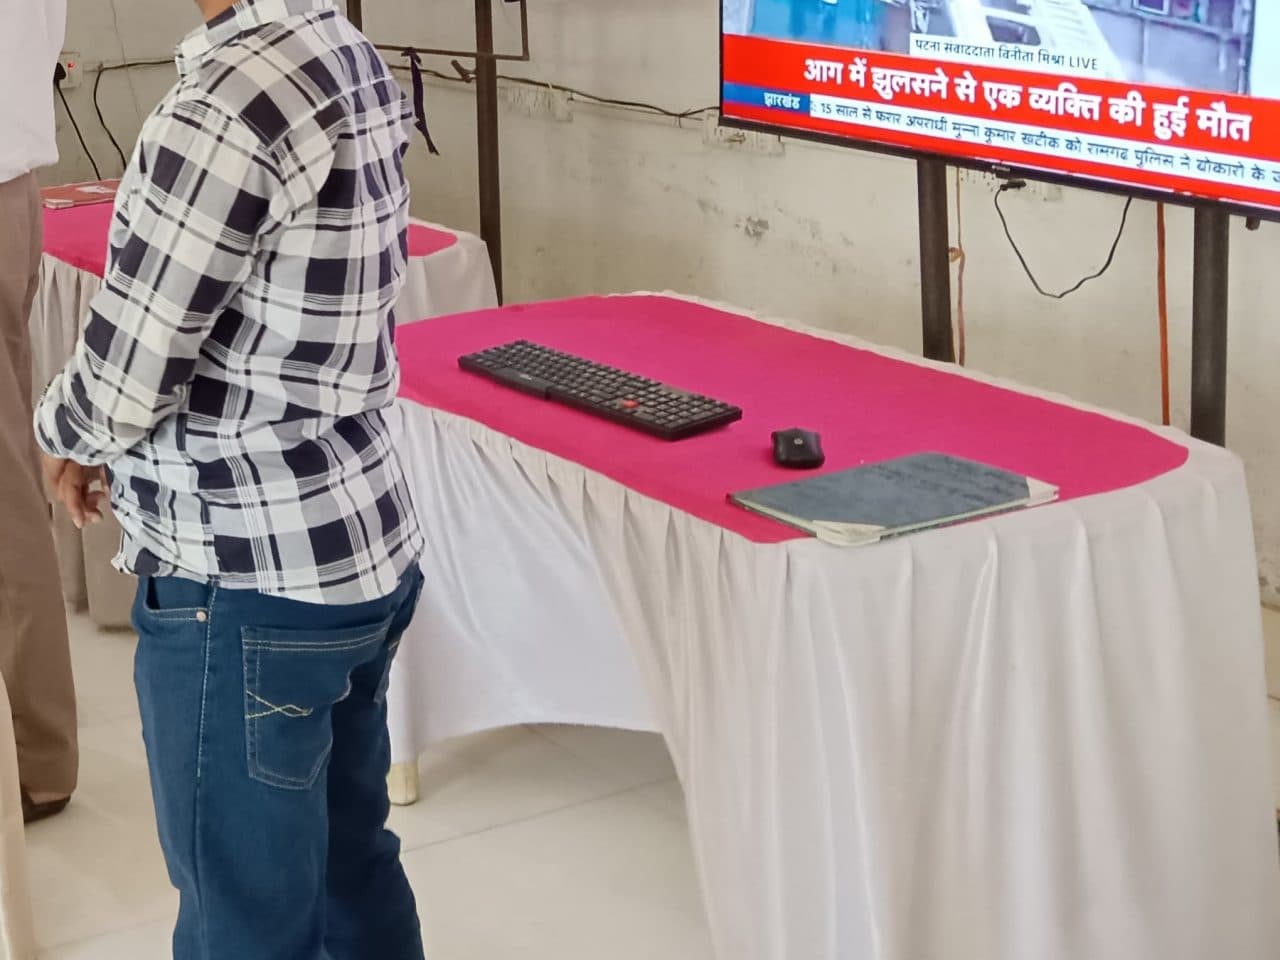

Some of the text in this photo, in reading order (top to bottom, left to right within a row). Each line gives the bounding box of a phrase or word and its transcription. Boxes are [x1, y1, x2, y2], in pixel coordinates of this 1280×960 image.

[915, 39, 940, 53] पटना
[999, 45, 1034, 63] विनीता
[1038, 49, 1066, 65] मिश्रा
[1069, 56, 1098, 70] LIVE
[763, 92, 800, 110] झारखंड
[804, 57, 1253, 142] आग में झुलसने से एक व्यक्ति की हुई मौत
[821, 103, 832, 114] 15
[835, 104, 858, 119] साल
[862, 105, 872, 121] से
[876, 110, 902, 125] फरार
[907, 115, 947, 133] अपराधी
[952, 122, 980, 138] मुन्ना
[984, 127, 1016, 144] कुमार
[1021, 131, 1060, 150] खटीक
[1065, 136, 1082, 153] को
[1134, 147, 1174, 168] पुलिस
[1180, 153, 1190, 170] ने
[1197, 156, 1244, 178] बोकारो
[1251, 163, 1266, 181] के
